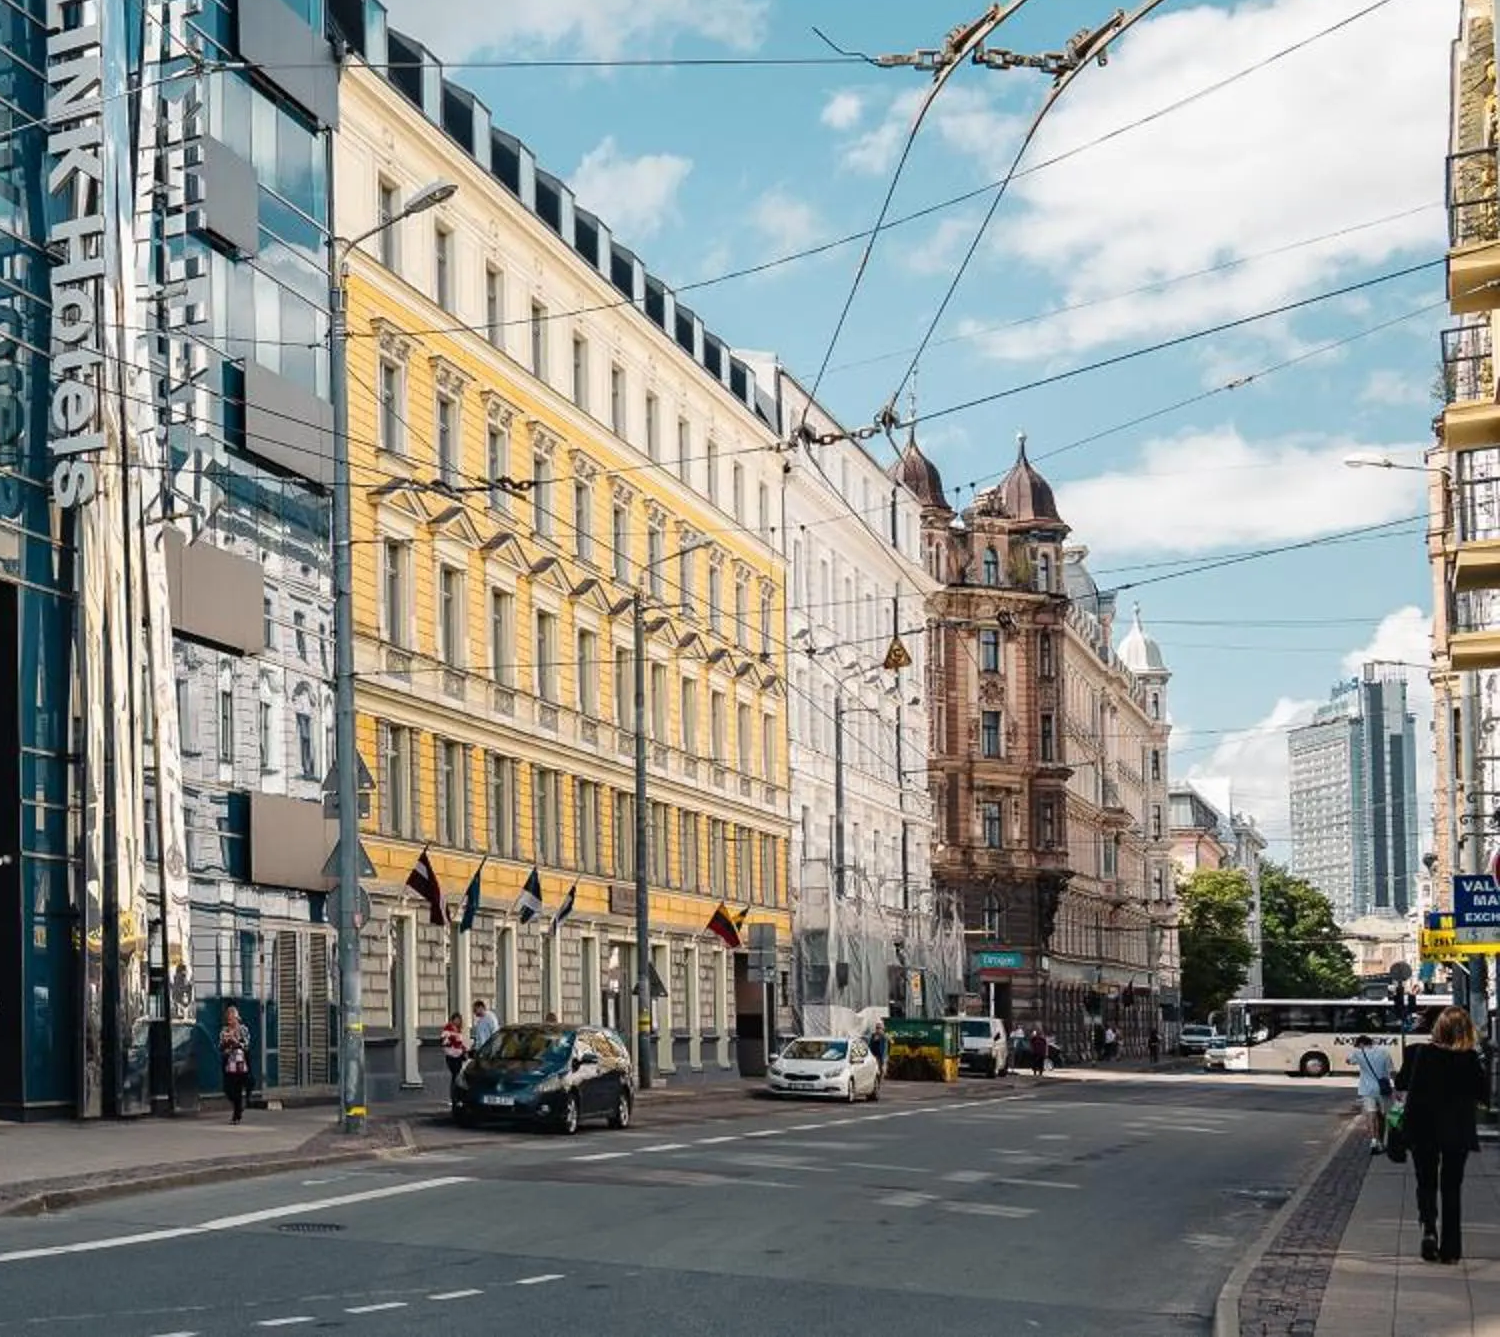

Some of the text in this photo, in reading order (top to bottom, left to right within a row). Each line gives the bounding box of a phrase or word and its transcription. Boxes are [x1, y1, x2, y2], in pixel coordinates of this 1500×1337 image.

[48, 212, 106, 509] Hotels
[1462, 880, 1500, 893] VAL
[1473, 894, 1500, 906] MA
